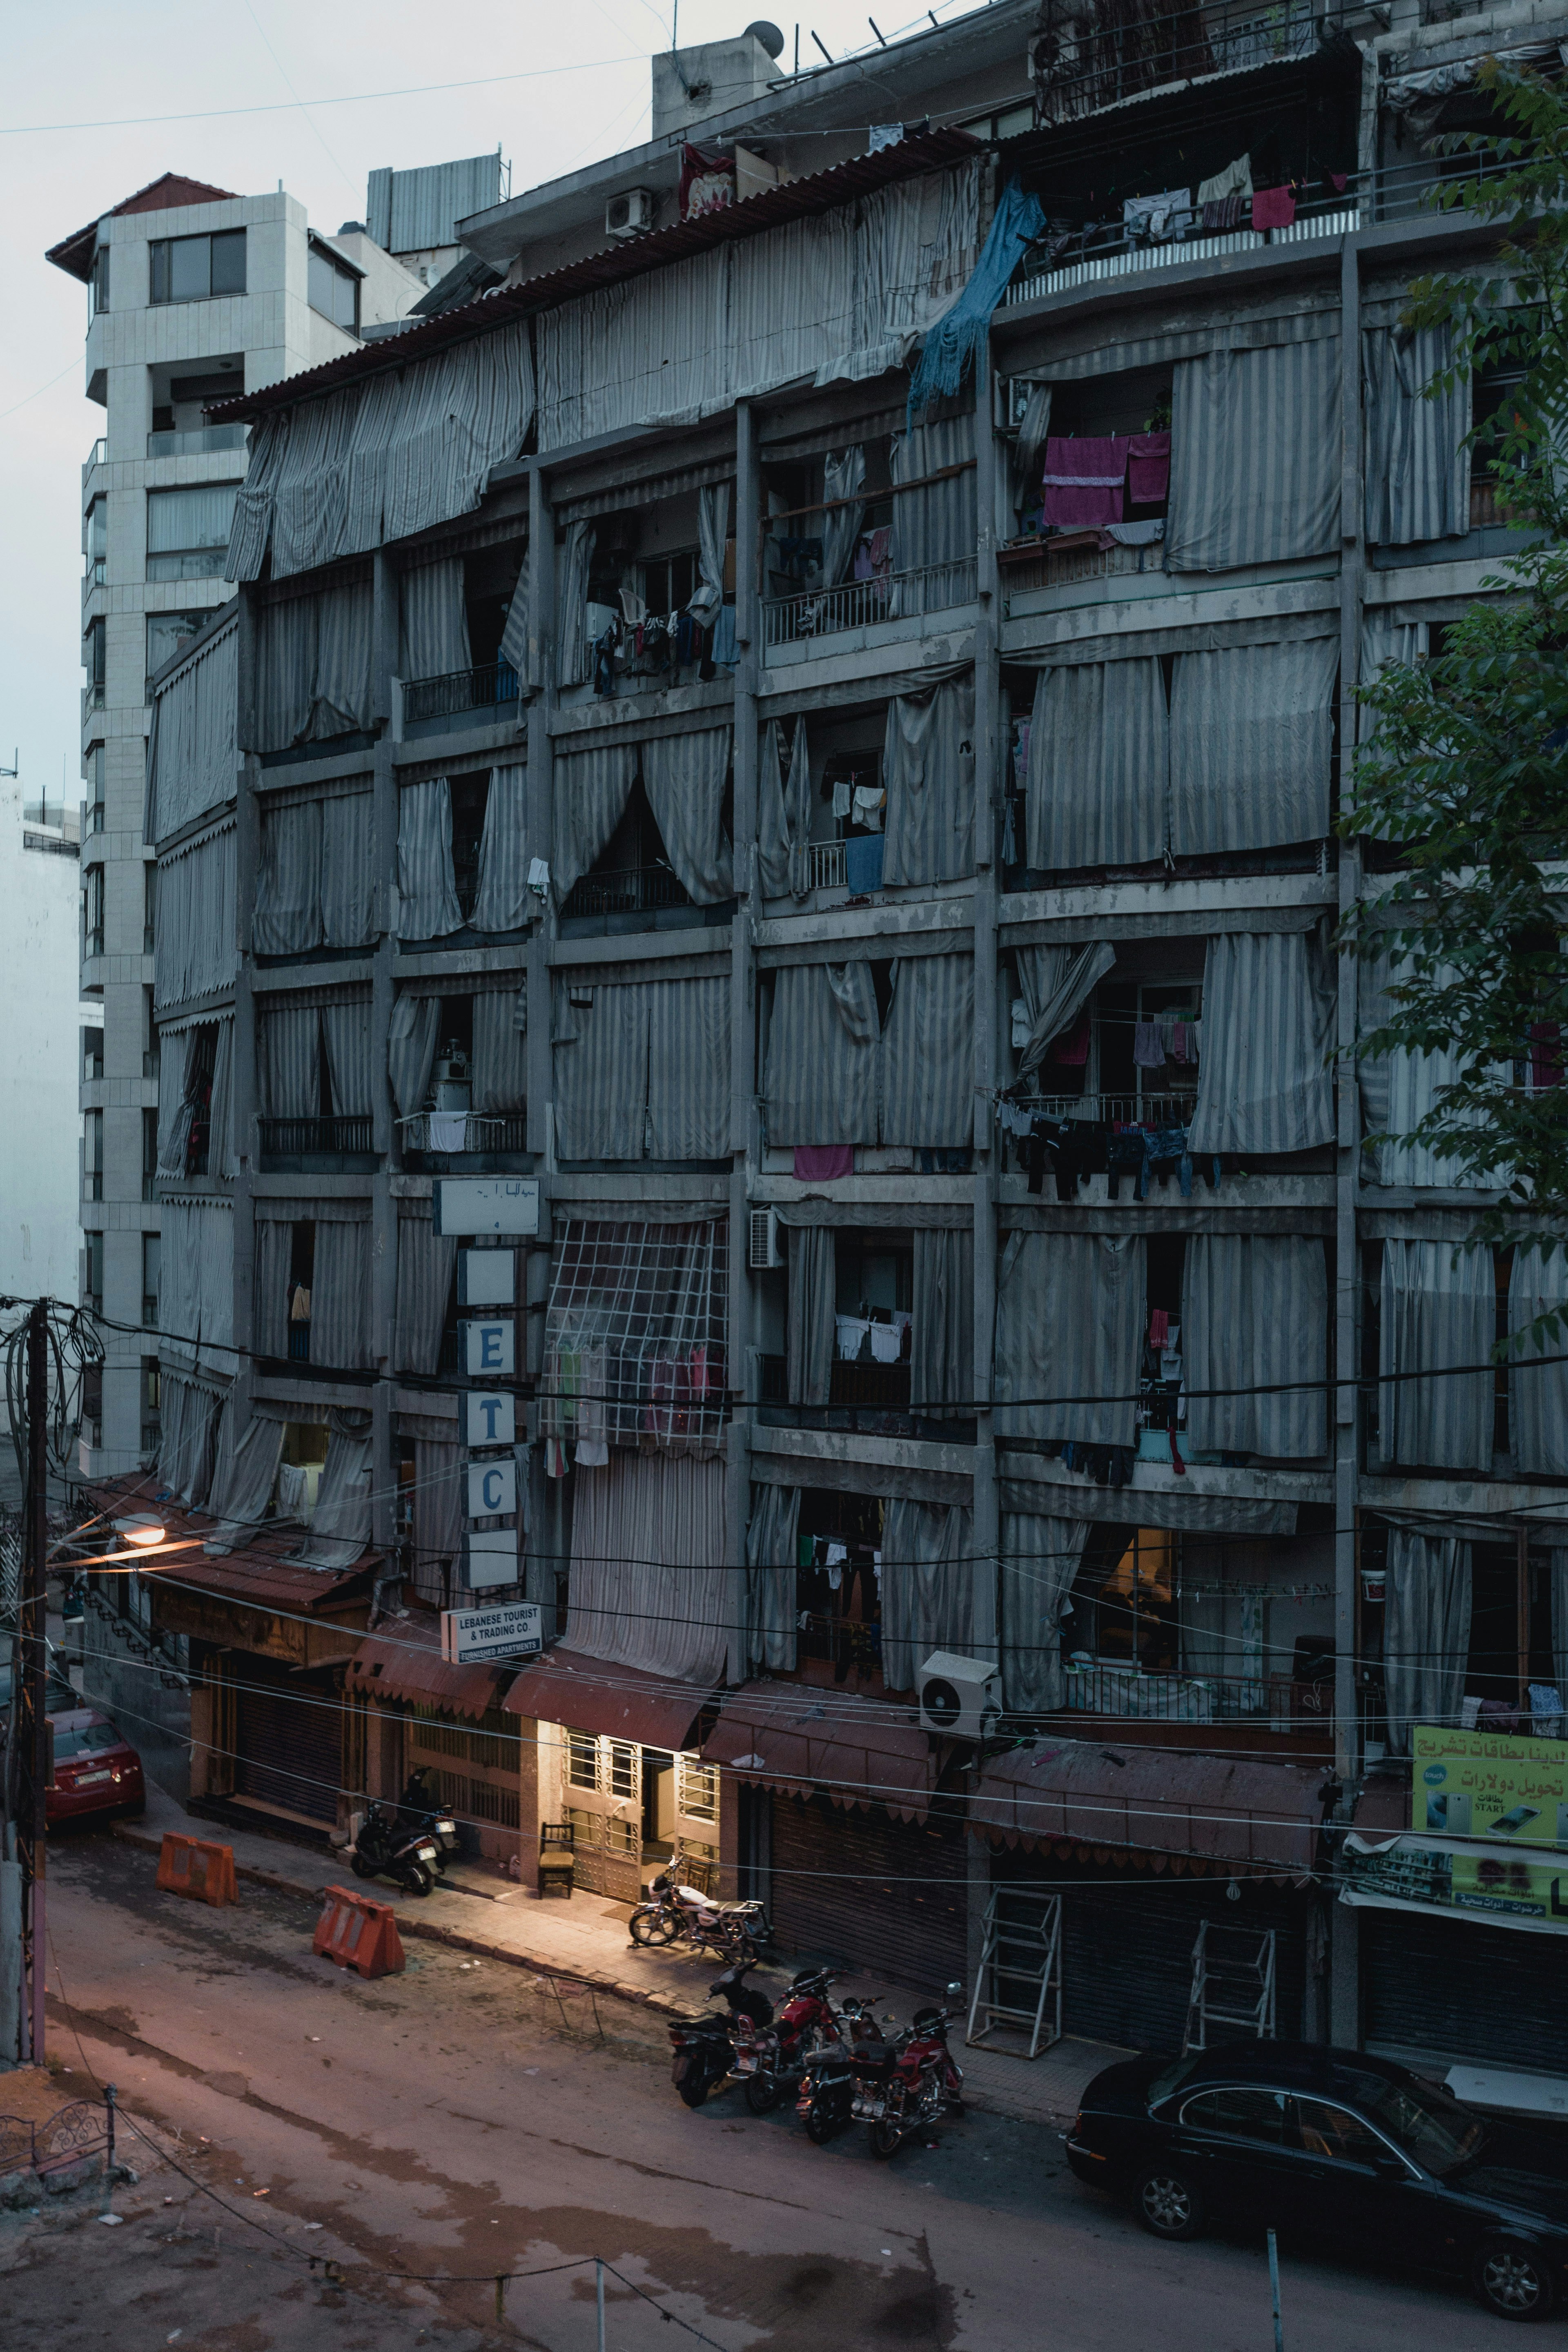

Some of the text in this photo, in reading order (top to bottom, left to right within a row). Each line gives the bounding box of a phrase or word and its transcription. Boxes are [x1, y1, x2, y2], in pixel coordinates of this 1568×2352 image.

[460, 1608, 538, 1629] LEBANESE TOURIST
[471, 1622, 531, 1641] & TRADING CO.
[461, 1641, 537, 1661] FURNISHED APARTMENTS
[1418, 1737, 1467, 1757] تشريج
[1470, 1740, 1524, 1767] بطاقات
[1461, 1771, 1564, 1800] تحويل دولارات
[1475, 1802, 1506, 1813] START
[1477, 1794, 1503, 1804] بطاقات
[1460, 1894, 1483, 1906] صحية
[1484, 1898, 1504, 1909] أدوات
